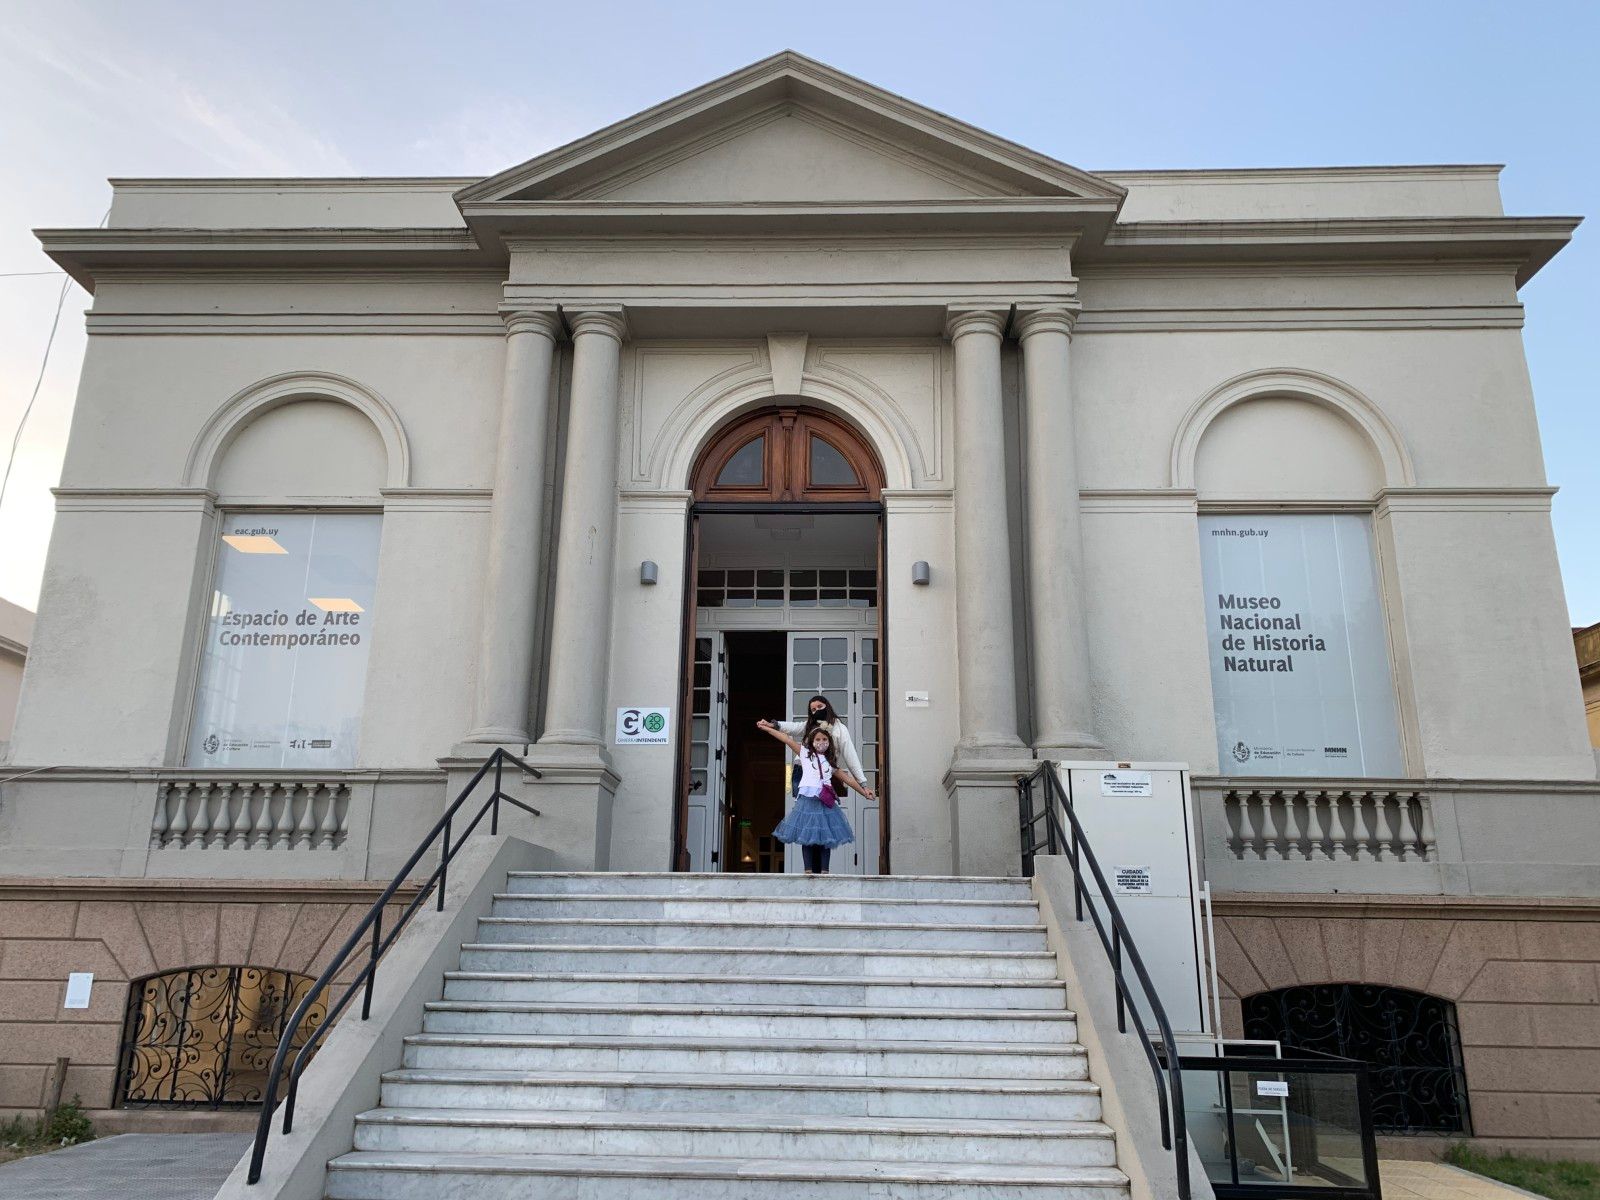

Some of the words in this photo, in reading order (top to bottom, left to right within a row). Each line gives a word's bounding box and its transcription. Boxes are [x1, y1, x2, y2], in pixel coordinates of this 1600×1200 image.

[235, 527, 279, 536] eac.gub.uy
[1211, 528, 1269, 538] mnhn.gub.uy
[1218, 594, 1281, 610] Museo
[221, 609, 289, 629] Espacio
[295, 609, 317, 626] de
[323, 611, 360, 626] Arte
[1219, 613, 1301, 631] Nacional
[219, 628, 361, 650] Contemporáneo
[1222, 634, 1245, 651] de
[1253, 634, 1326, 652] Historia
[1223, 655, 1294, 673] Natural
